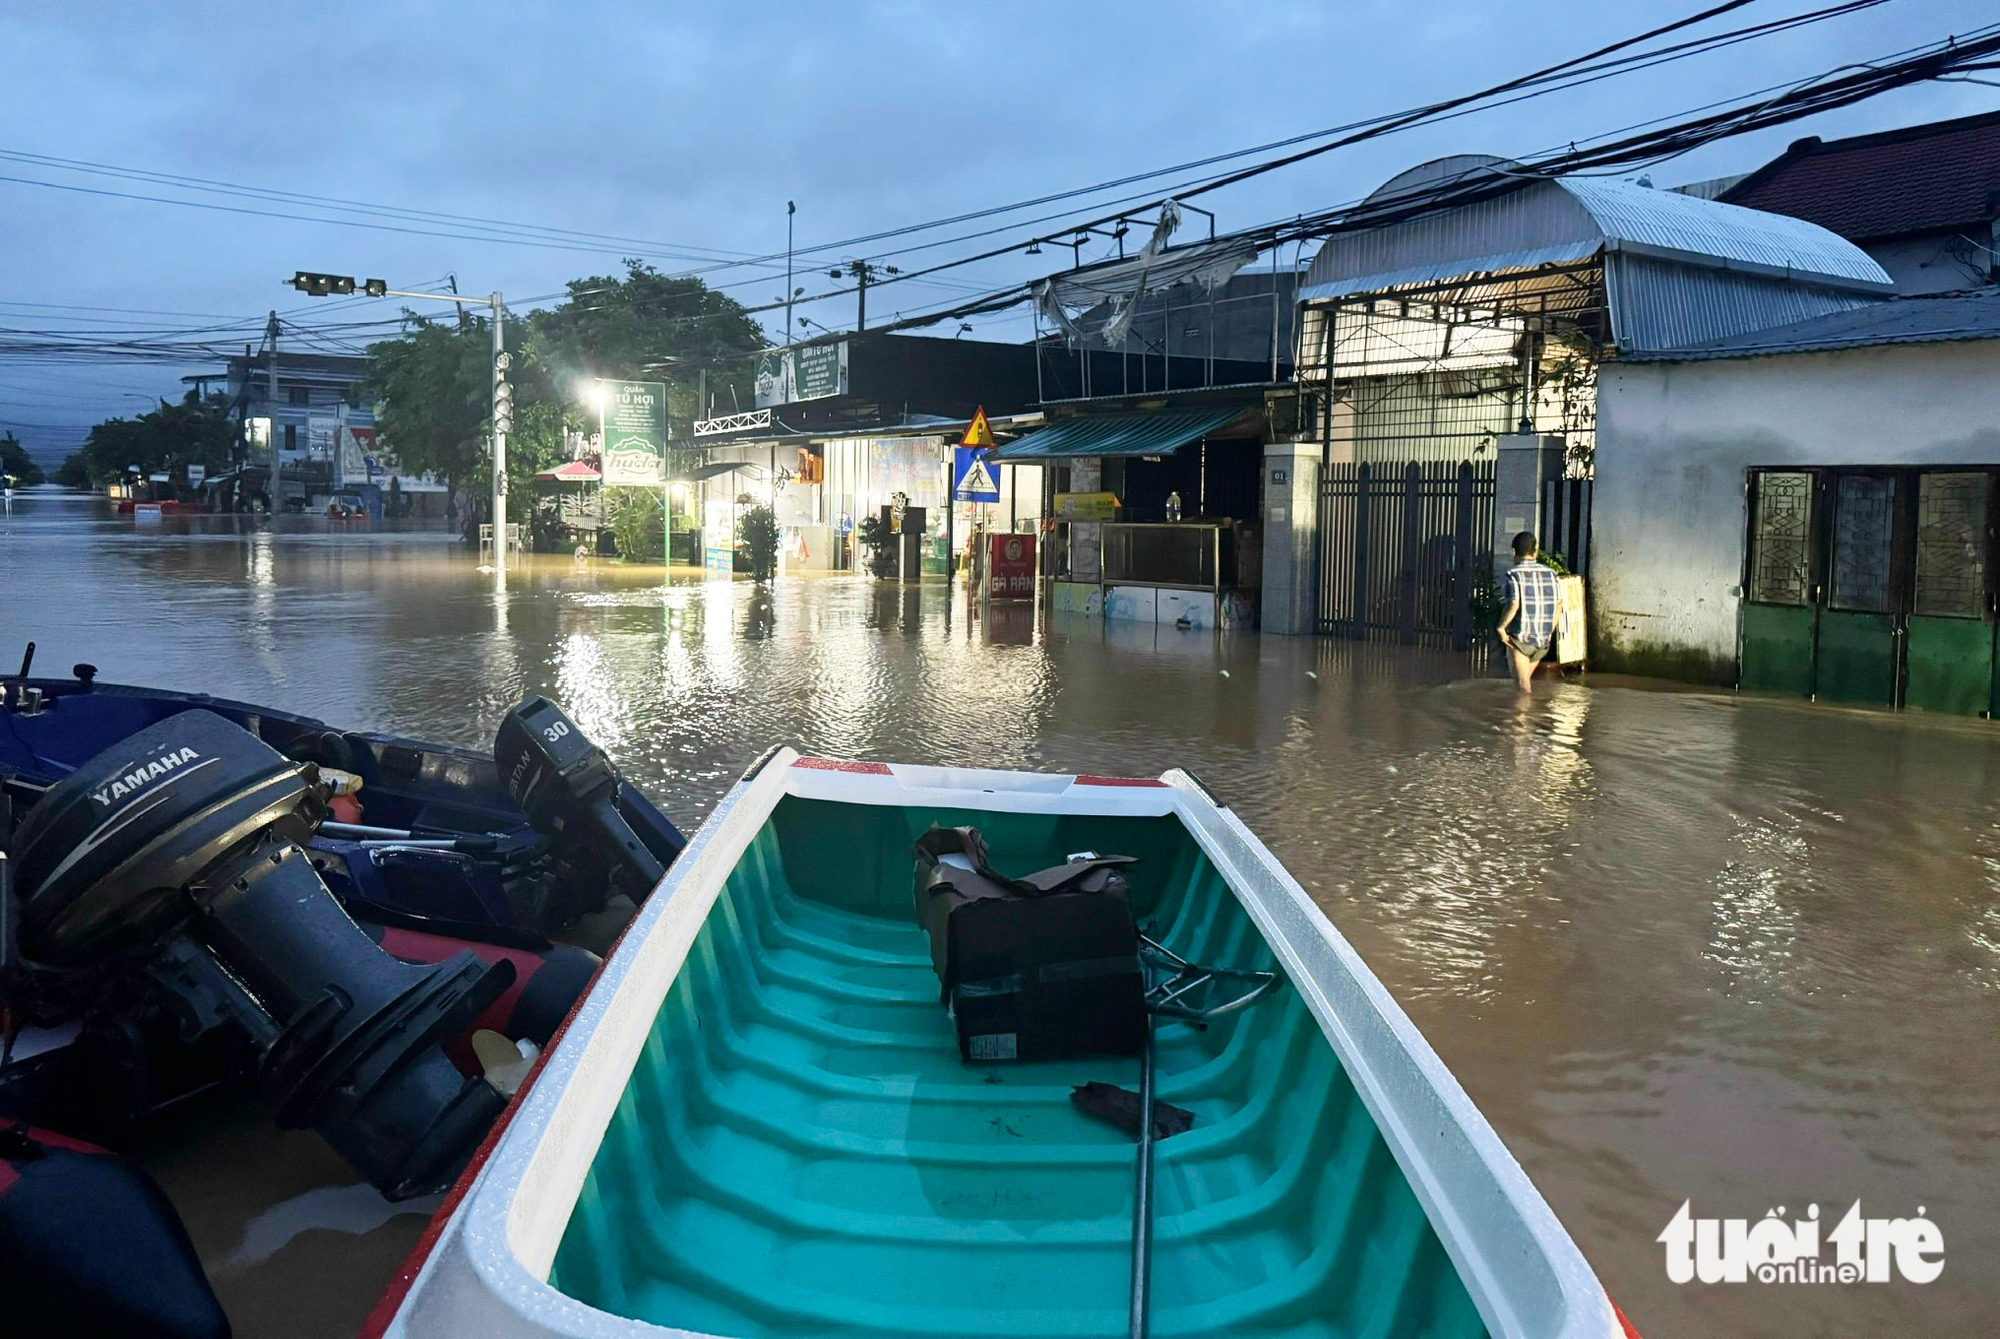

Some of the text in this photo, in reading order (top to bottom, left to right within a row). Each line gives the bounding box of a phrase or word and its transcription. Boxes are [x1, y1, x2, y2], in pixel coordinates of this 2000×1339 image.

[992, 572, 1034, 591] GÀ RÁN
[543, 721, 570, 742] 30
[92, 746, 200, 807] YAMAHA
